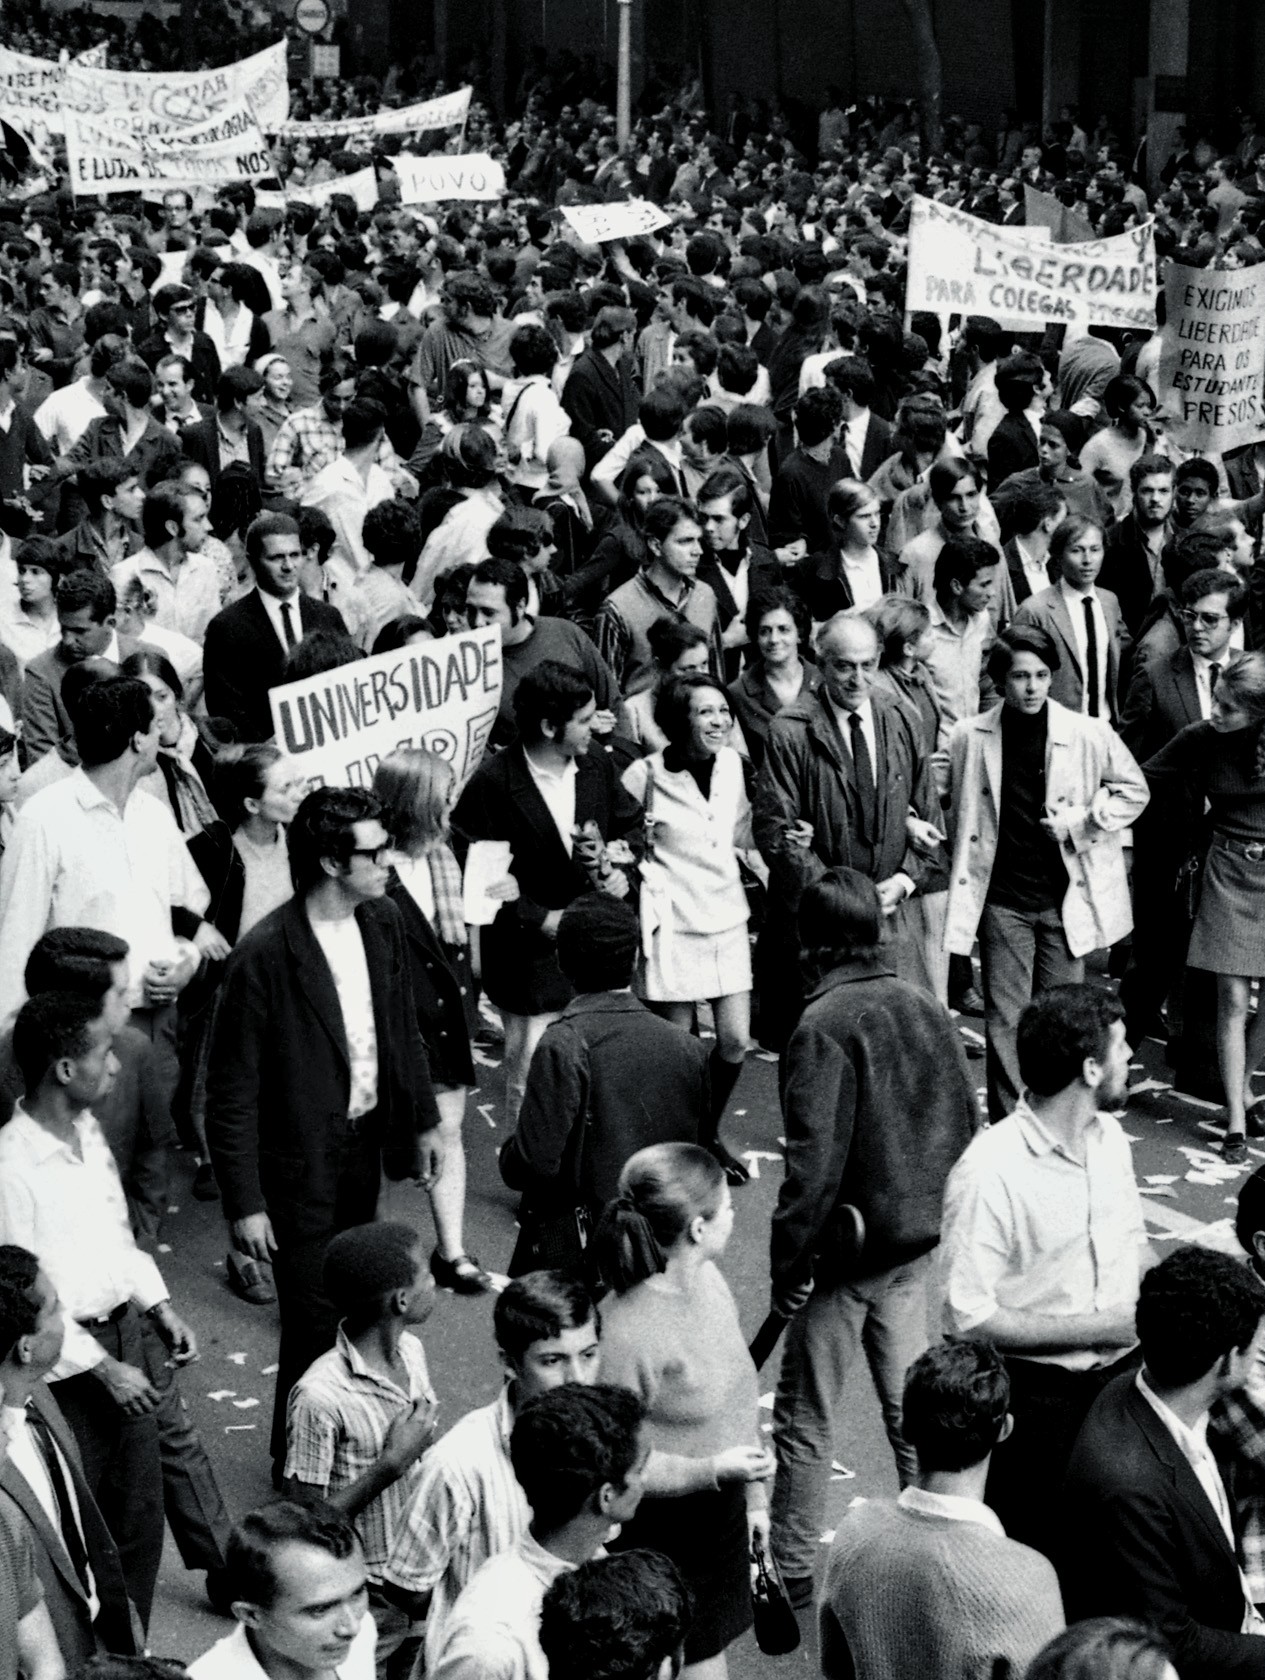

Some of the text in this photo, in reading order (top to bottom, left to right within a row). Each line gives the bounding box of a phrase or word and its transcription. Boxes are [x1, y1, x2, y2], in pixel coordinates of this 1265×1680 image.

[236, 150, 270, 175] NOS
[412, 172, 487, 193] POVO
[925, 276, 976, 307] PARA
[989, 284, 1077, 320] COLEGAS
[1178, 316, 1260, 344] LIBERDADE
[1181, 348, 1250, 371] PARA OS
[1183, 395, 1257, 427] PRESOS
[279, 639, 499, 754] UNIVERSIDADE
